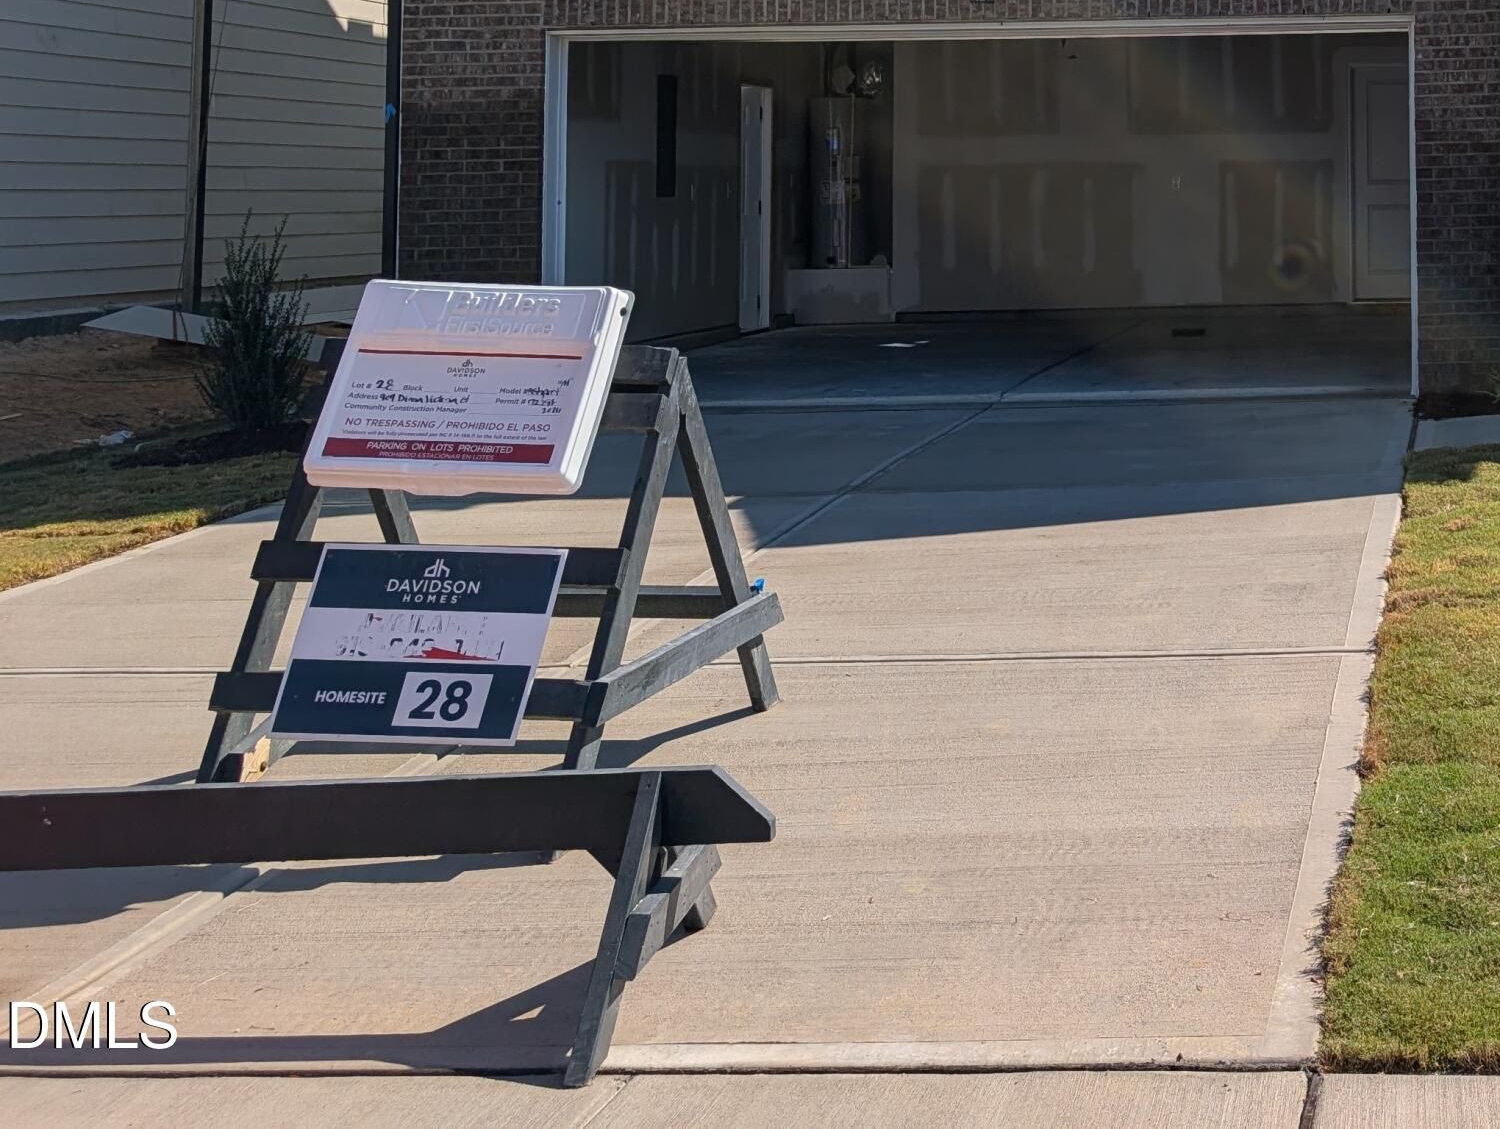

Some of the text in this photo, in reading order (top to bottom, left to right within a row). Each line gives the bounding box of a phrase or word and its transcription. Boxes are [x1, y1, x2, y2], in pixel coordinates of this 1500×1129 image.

[347, 392, 379, 400] Address
[345, 402, 387, 412] Community
[389, 404, 434, 412] Construction
[345, 417, 361, 426] NO
[366, 418, 435, 429] TRESPASSING
[446, 421, 504, 431] PROHIBIDO
[507, 423, 519, 431] EL
[522, 423, 551, 432] PASO
[366, 441, 513, 454] PARKING ON LOTS PROHIBITED
[417, 452, 460, 460] ESTACIONAR
[386, 578, 481, 594] DAVIDSON
[402, 594, 459, 604] HOMES
[314, 679, 473, 722] HOMESITE 28
